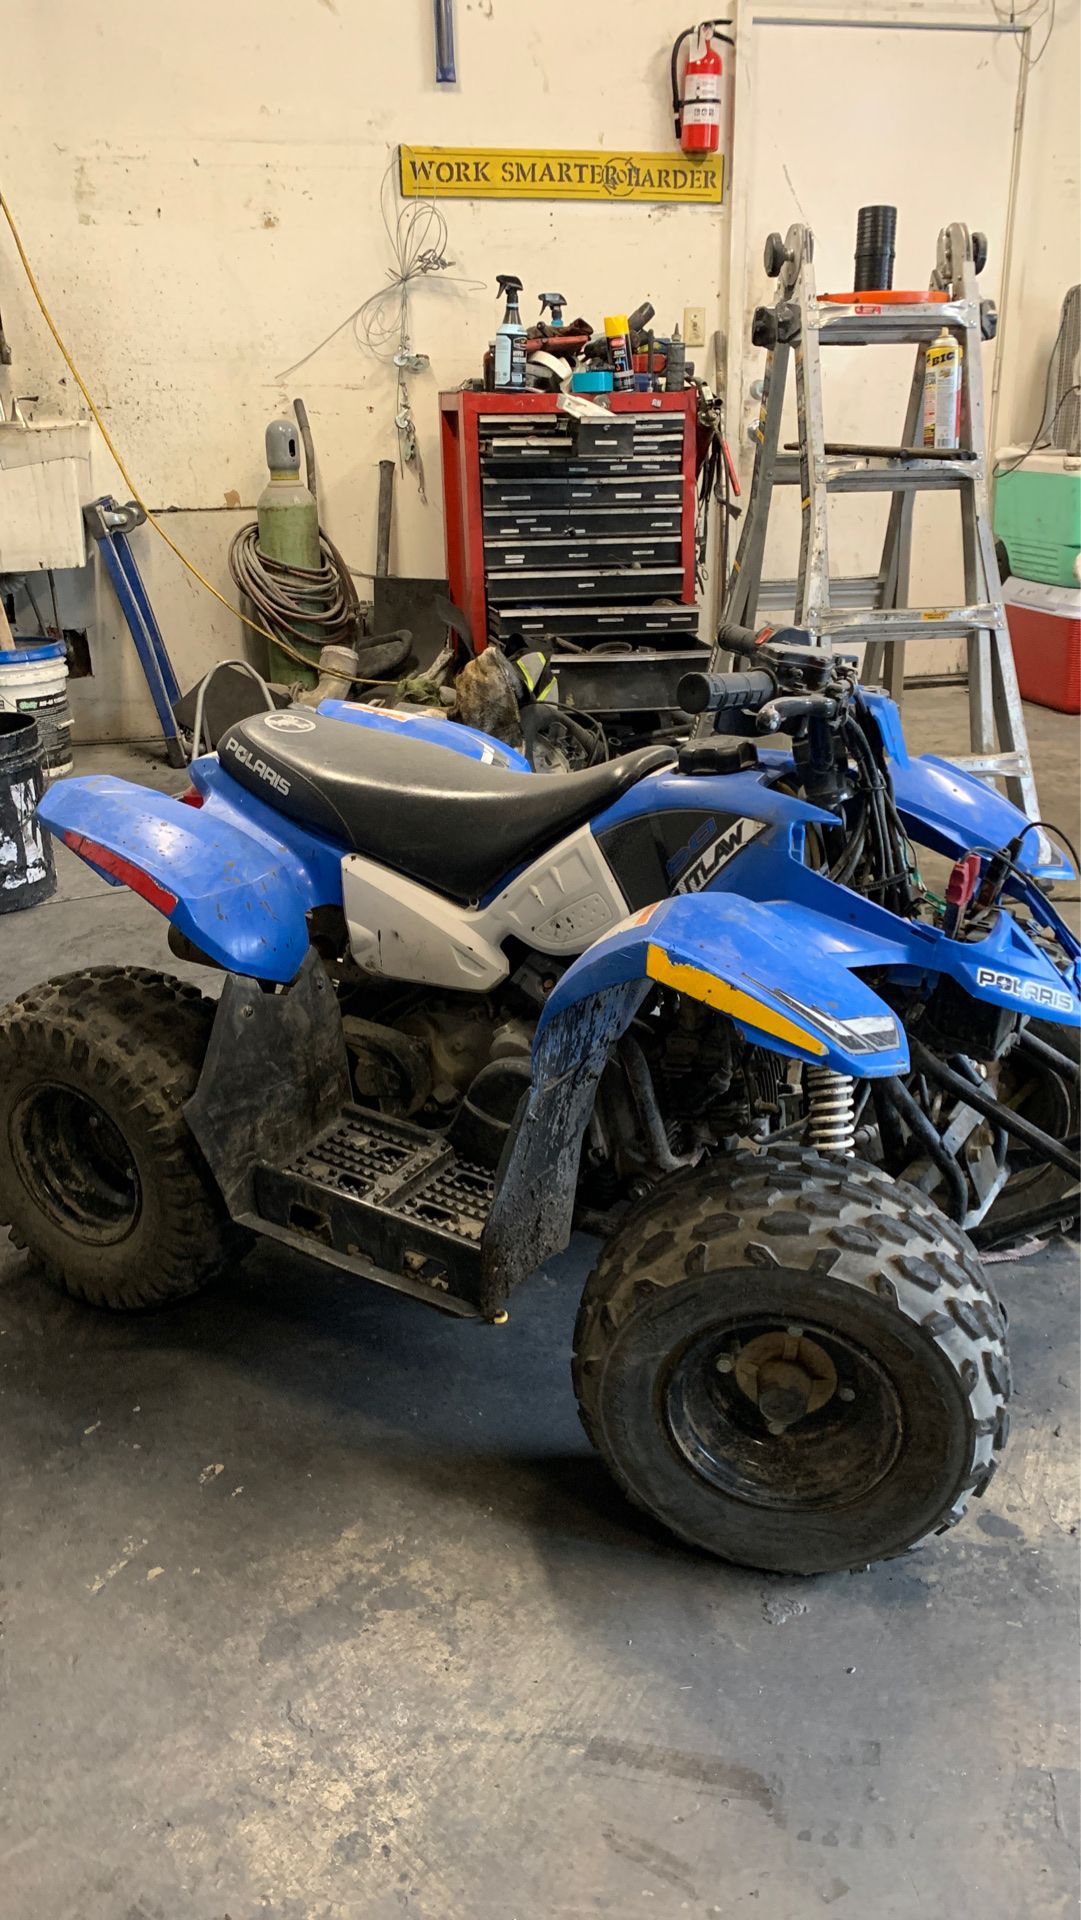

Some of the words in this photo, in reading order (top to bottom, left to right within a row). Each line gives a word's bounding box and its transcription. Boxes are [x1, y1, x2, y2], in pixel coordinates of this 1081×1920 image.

[409, 161, 490, 183] WORK
[501, 162, 618, 186] SMARTER
[627, 167, 717, 190] HARDER
[225, 737, 292, 797] POLARIS
[978, 967, 1073, 1012] POLARIS
